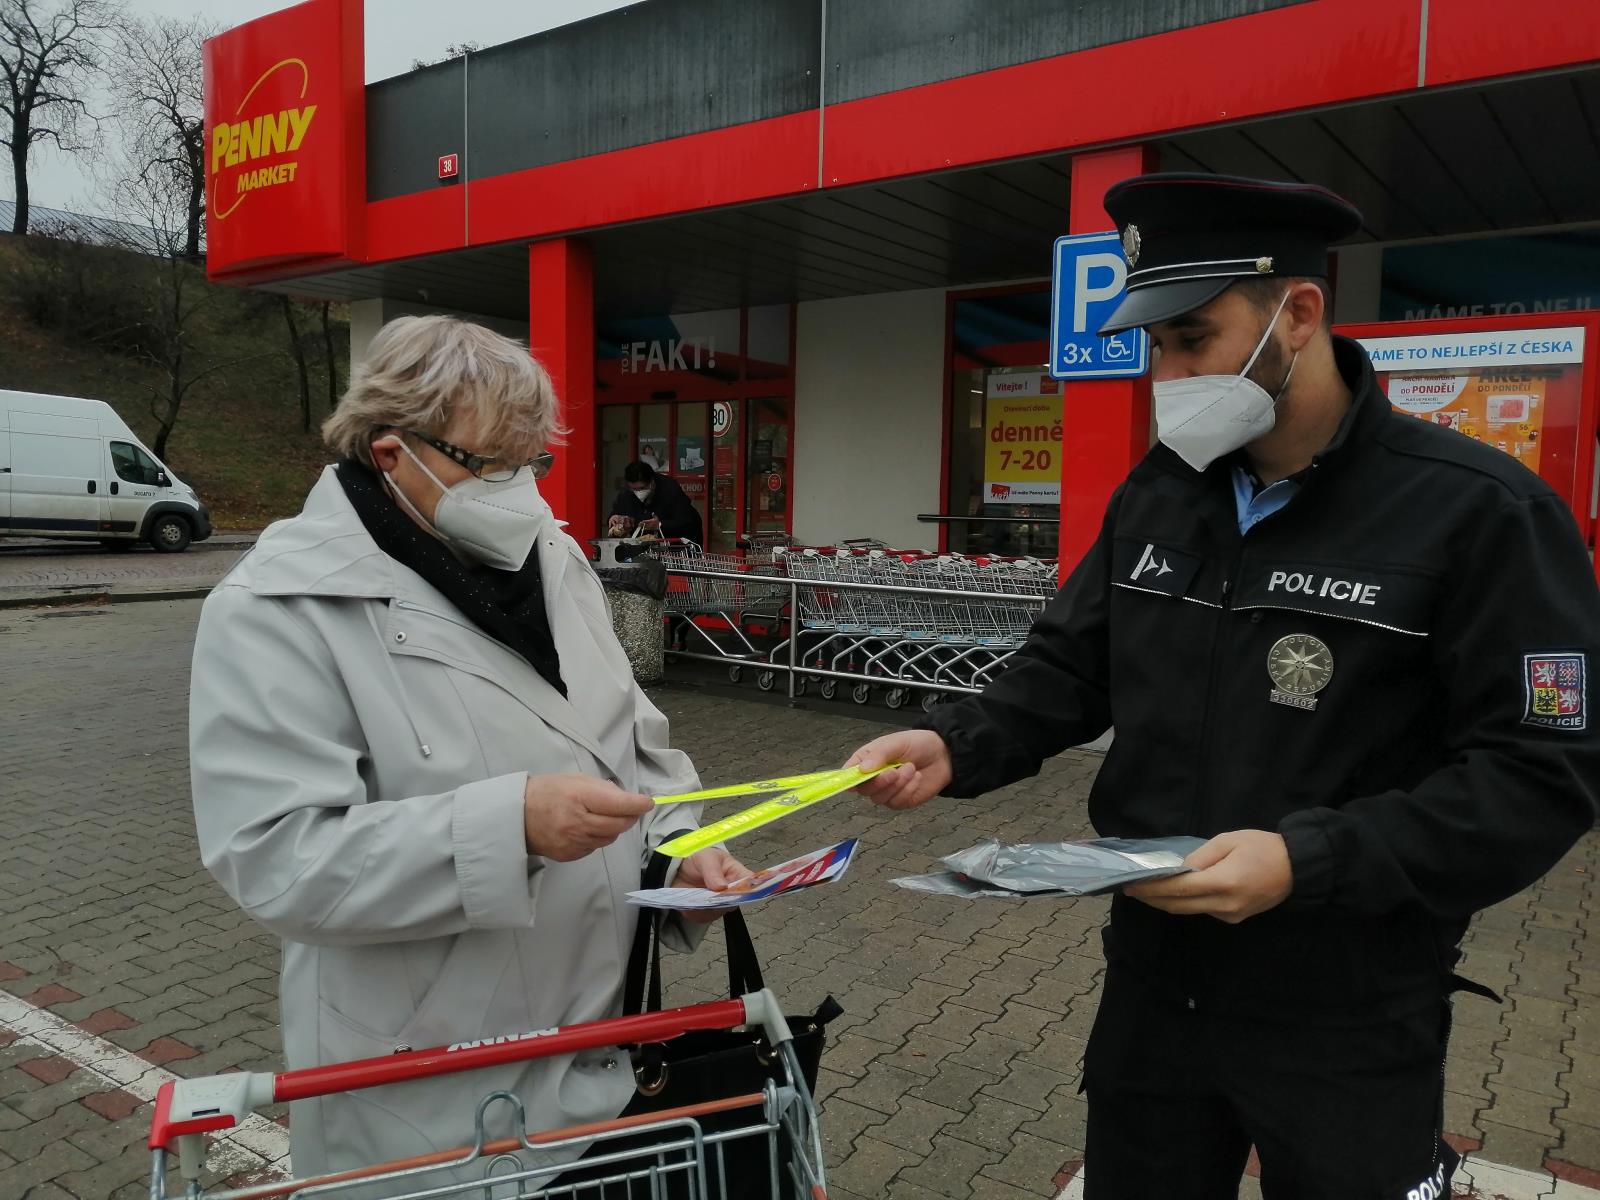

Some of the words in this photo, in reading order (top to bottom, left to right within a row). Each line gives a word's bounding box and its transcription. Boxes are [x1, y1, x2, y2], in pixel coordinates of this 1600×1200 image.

[211, 104, 318, 175] PENNY
[236, 162, 298, 193] MARKET
[443, 159, 452, 173] 38
[1073, 252, 1128, 333] P
[631, 336, 715, 374] FAKT!
[1063, 343, 1092, 364] 3x
[1408, 347, 1428, 360] TO
[1432, 342, 1503, 359] NEJLEPŠÍ
[1507, 343, 1520, 355] Z
[1520, 339, 1573, 354] ČESKA
[1412, 382, 1455, 394] PONDĚLÍ
[991, 418, 1063, 443] denně
[1000, 450, 1051, 471] 7-20
[1268, 571, 1381, 605] POLICIE
[1527, 716, 1582, 726] POLICIE
